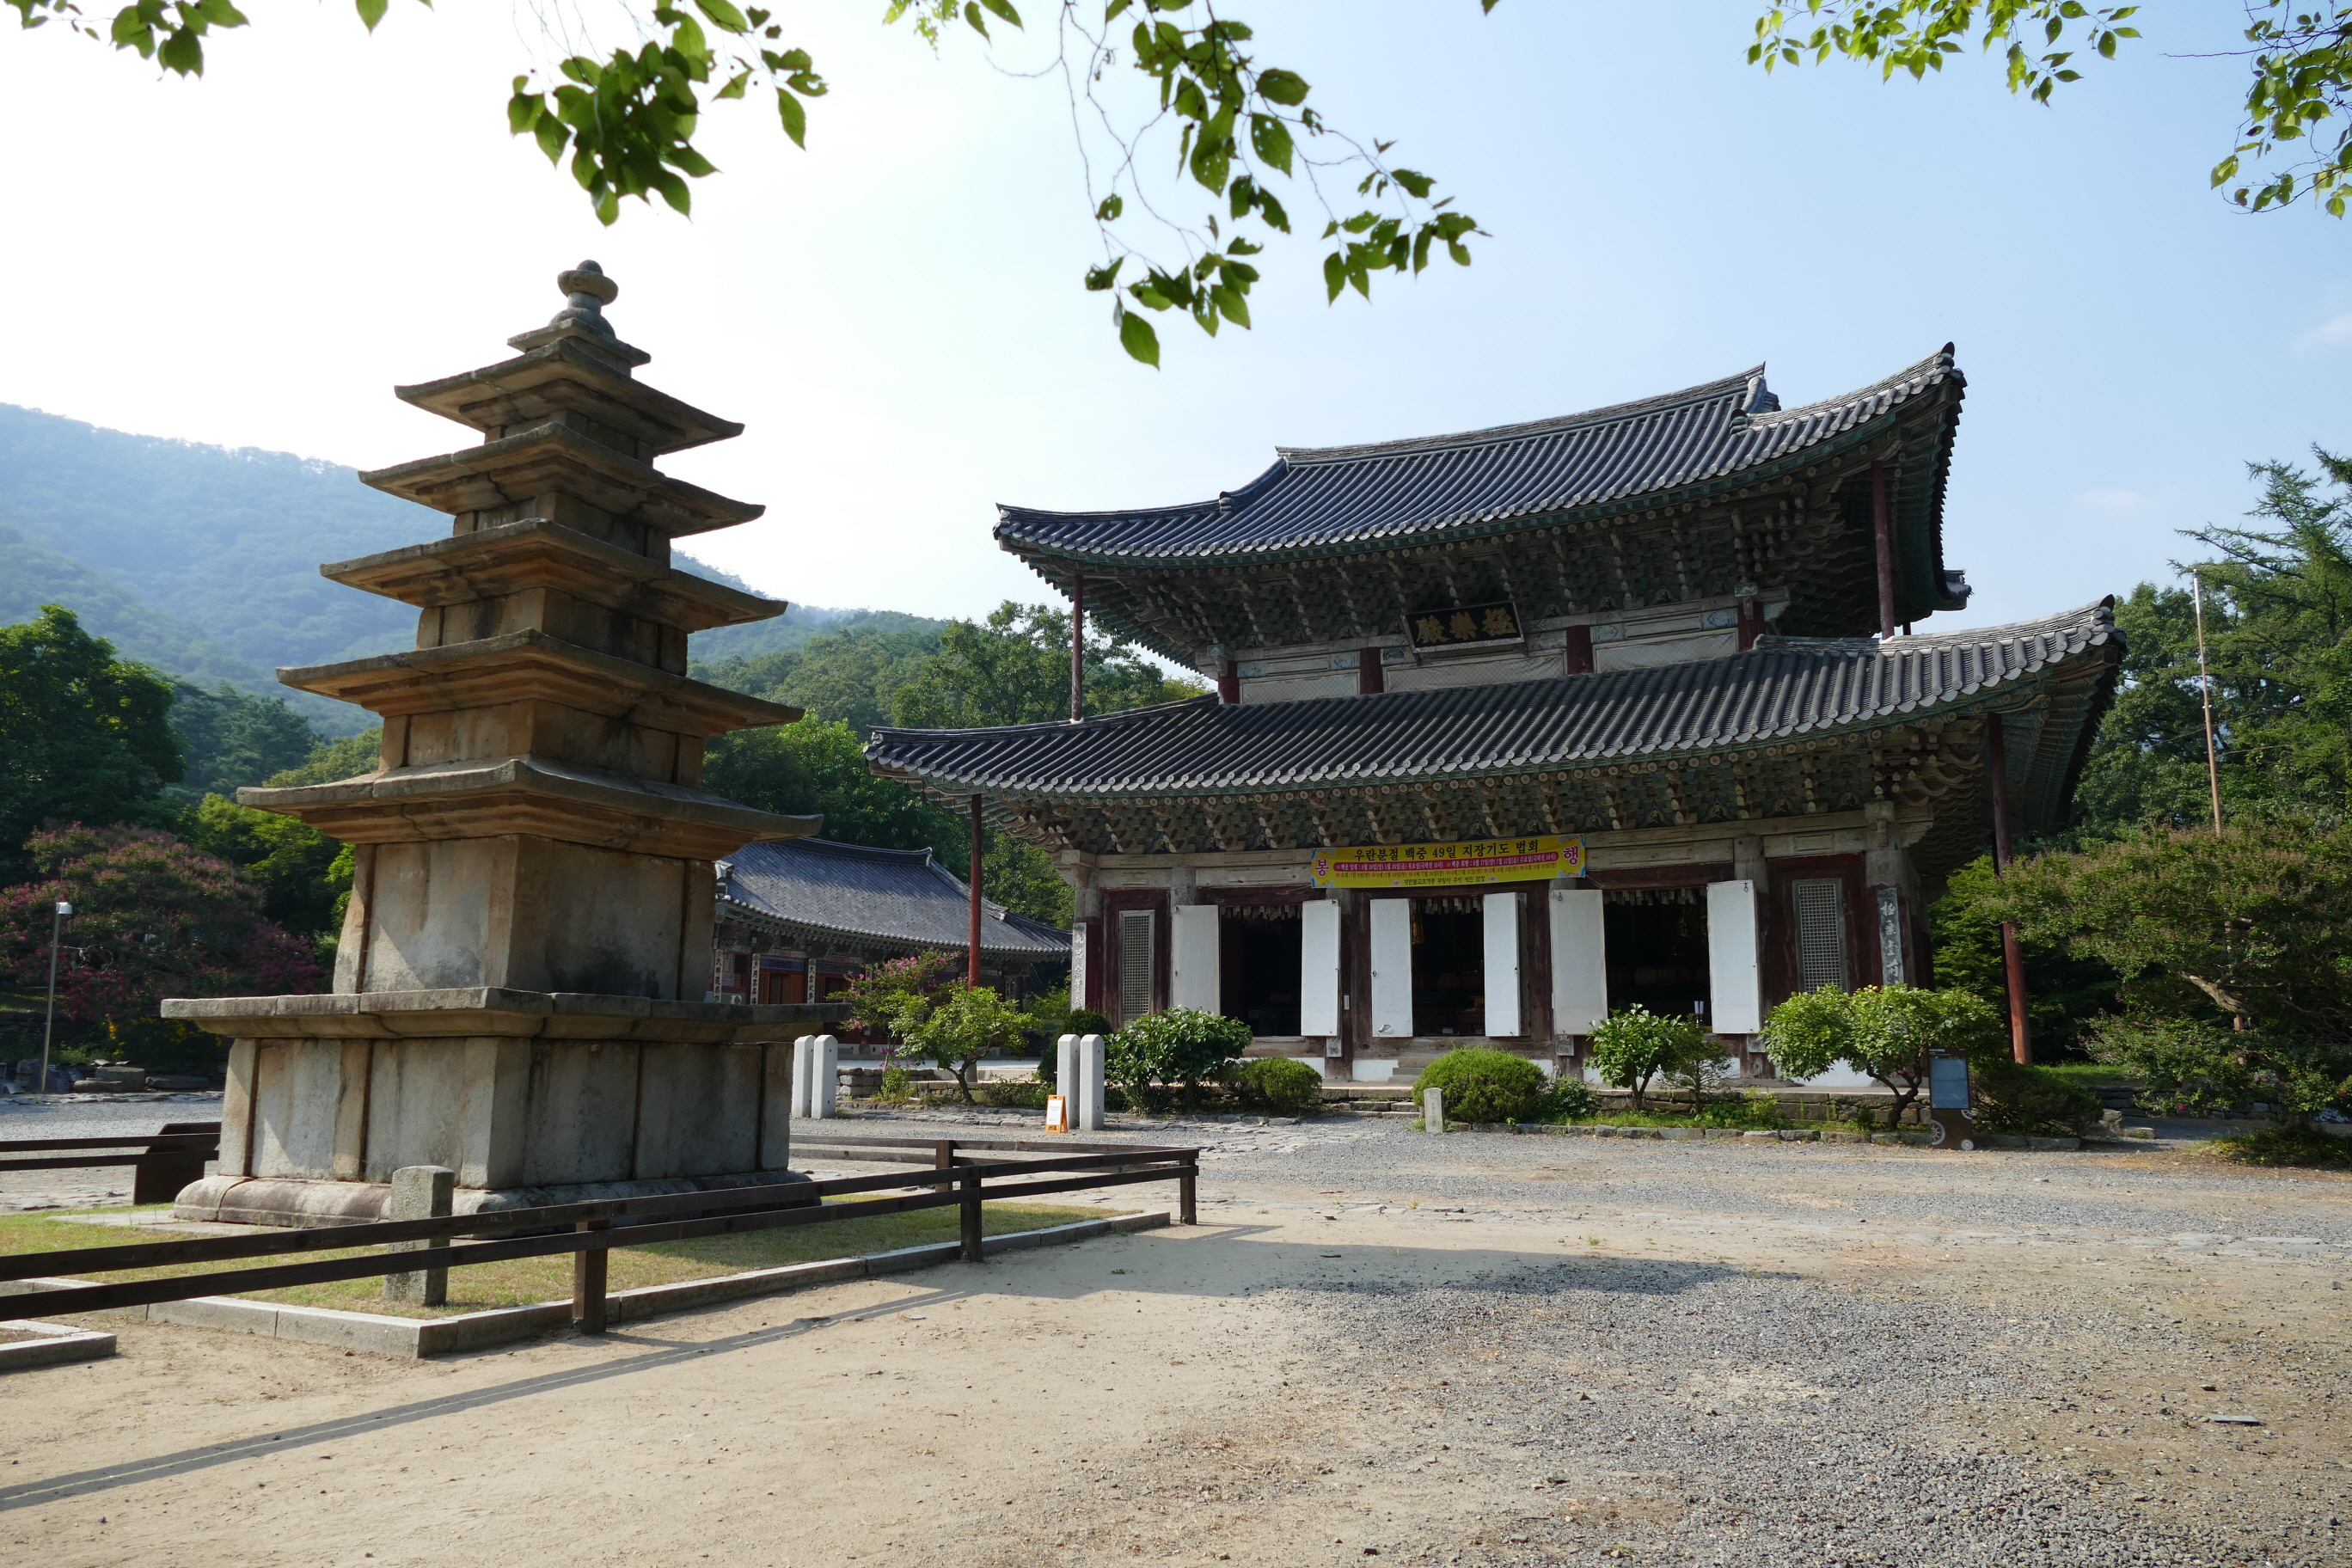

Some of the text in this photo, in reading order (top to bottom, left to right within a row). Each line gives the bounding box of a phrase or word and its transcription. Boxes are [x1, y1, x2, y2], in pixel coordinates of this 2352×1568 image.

[1354, 840, 1538, 861] 우란분절 백중 49일 지장기도 법회
[1562, 845, 1579, 866] 행
[1314, 858, 1330, 877] 봉
